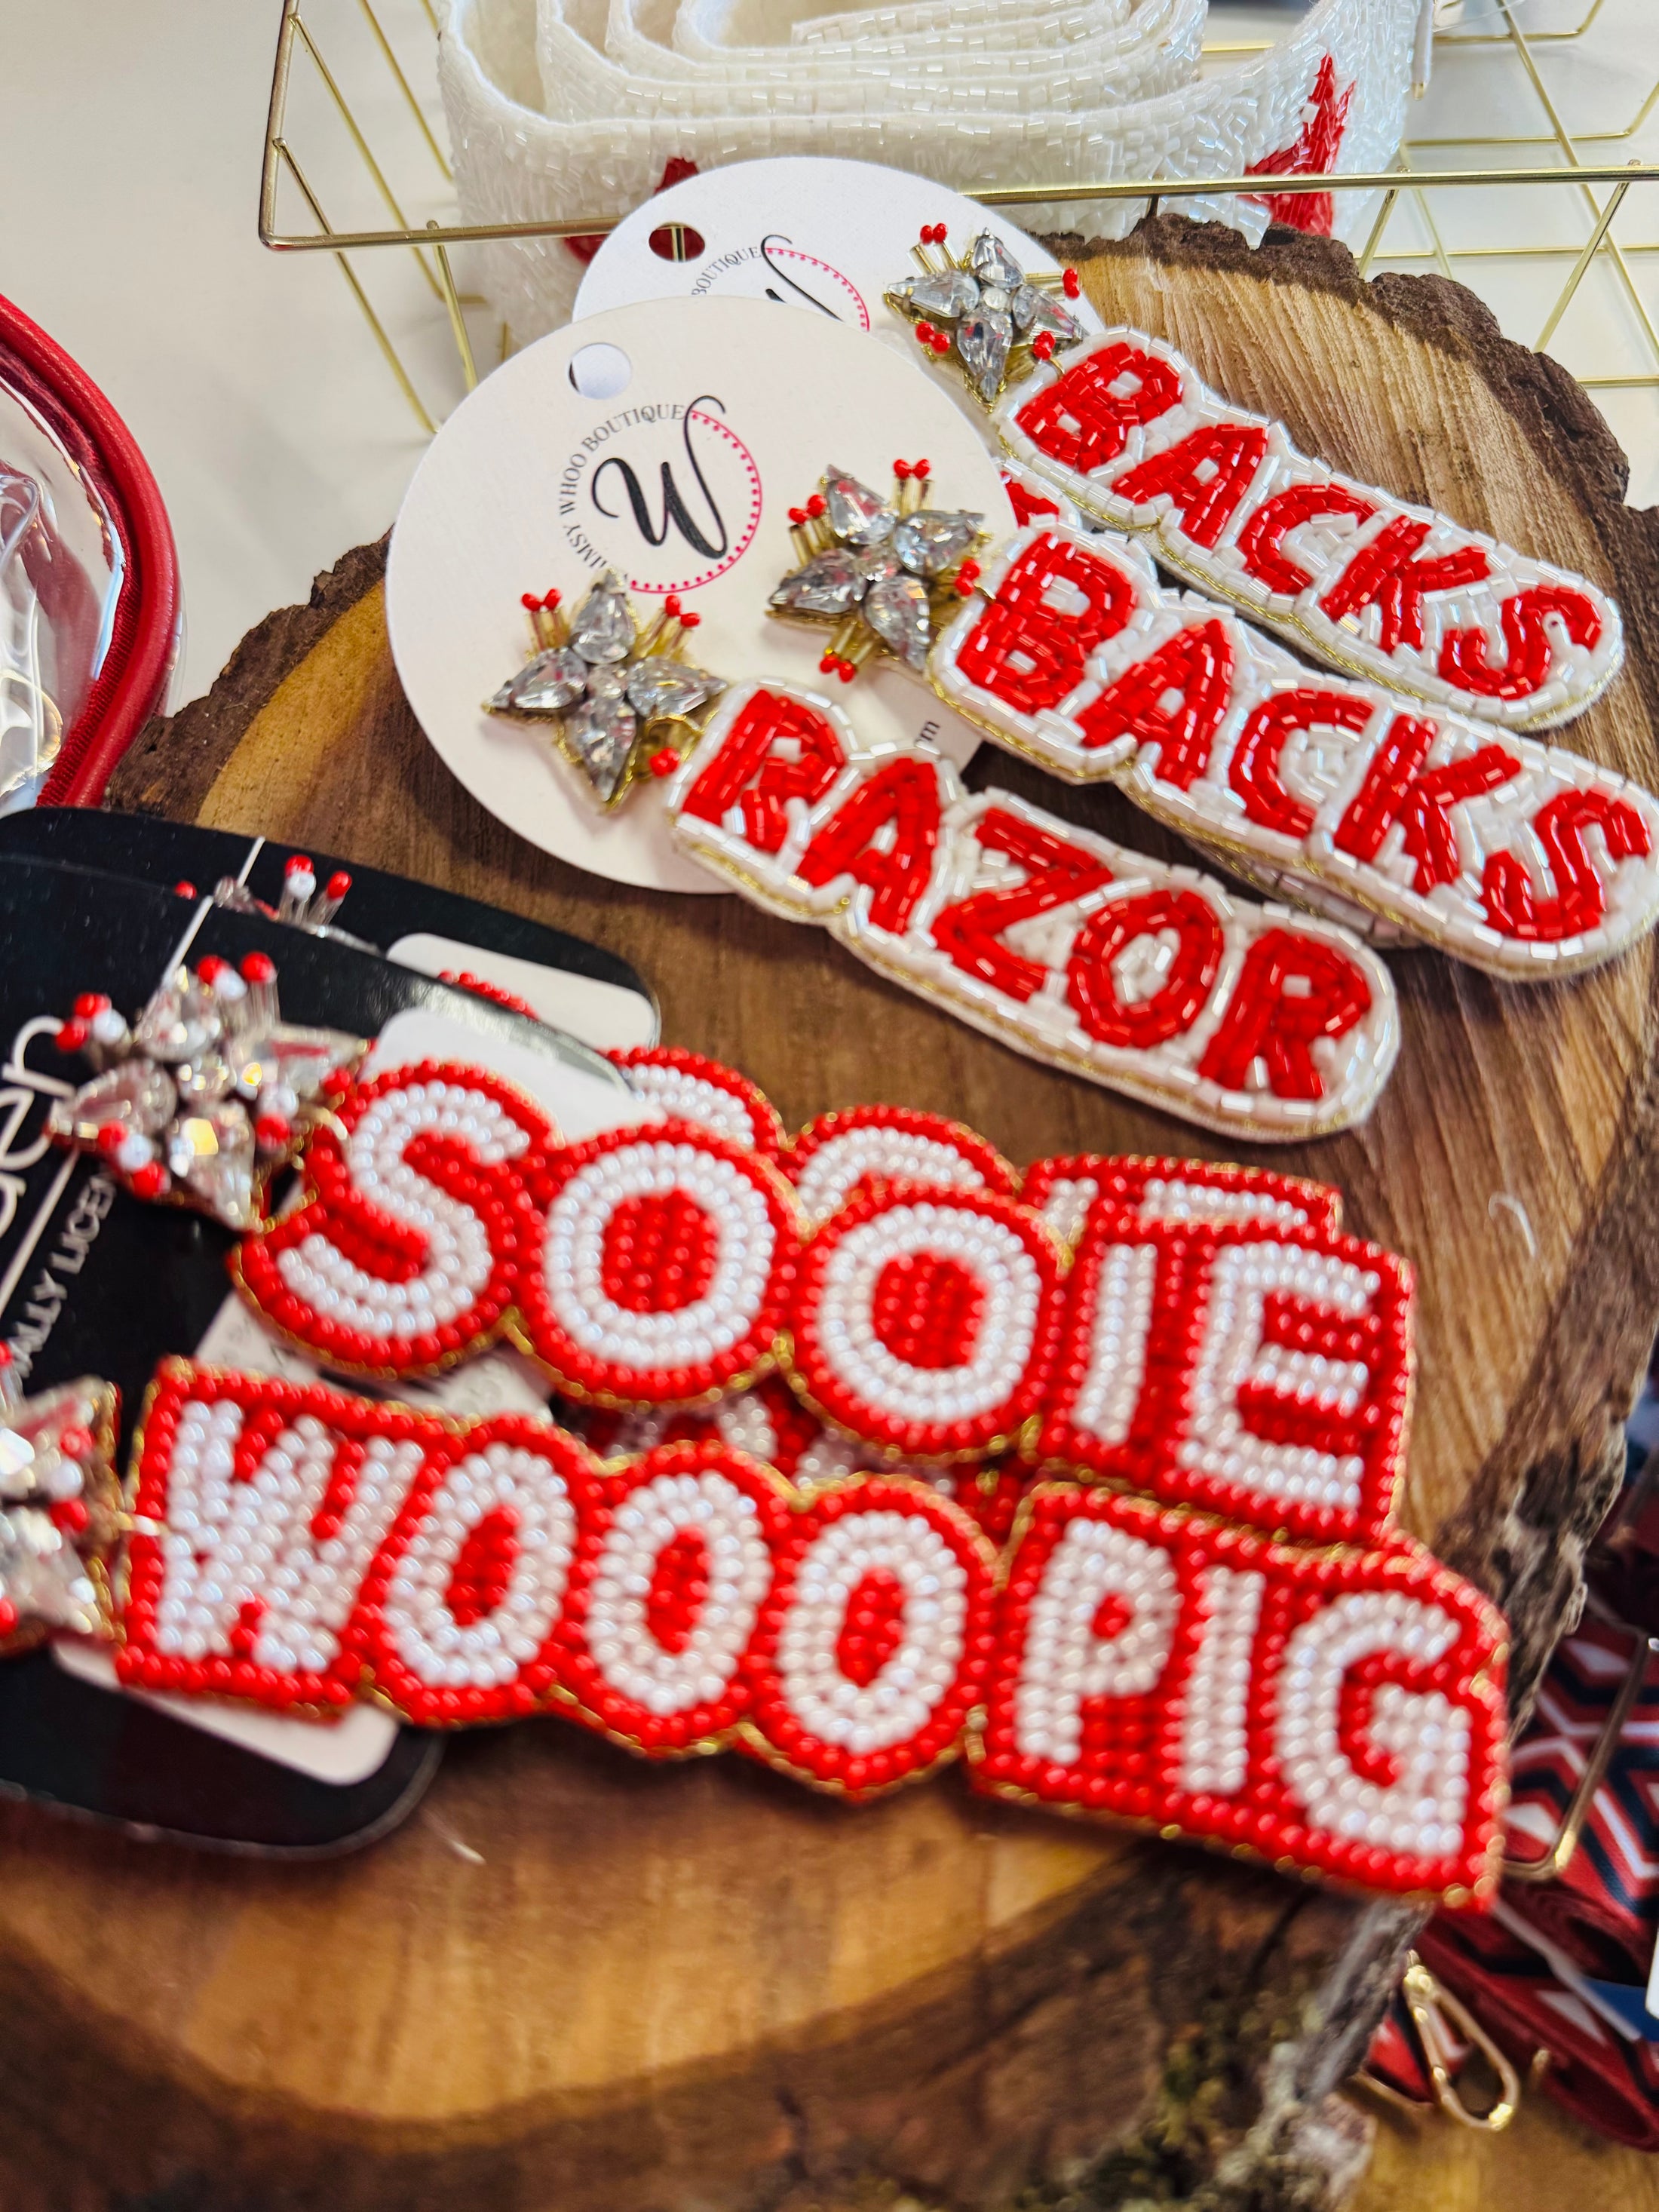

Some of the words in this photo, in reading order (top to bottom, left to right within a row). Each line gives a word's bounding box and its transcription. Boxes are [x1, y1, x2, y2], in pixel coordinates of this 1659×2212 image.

[560, 453, 588, 516] WHOO
[581, 403, 687, 453] BOUTIQUE
[1016, 342, 1602, 701] BACKS
[680, 687, 1373, 1101] RAZOR
[955, 531, 1651, 942] BACKS
[276, 1078, 1381, 1507] SOOIE
[155, 1399, 967, 1753] WOOO
[1016, 1516, 1472, 1856] PIG
